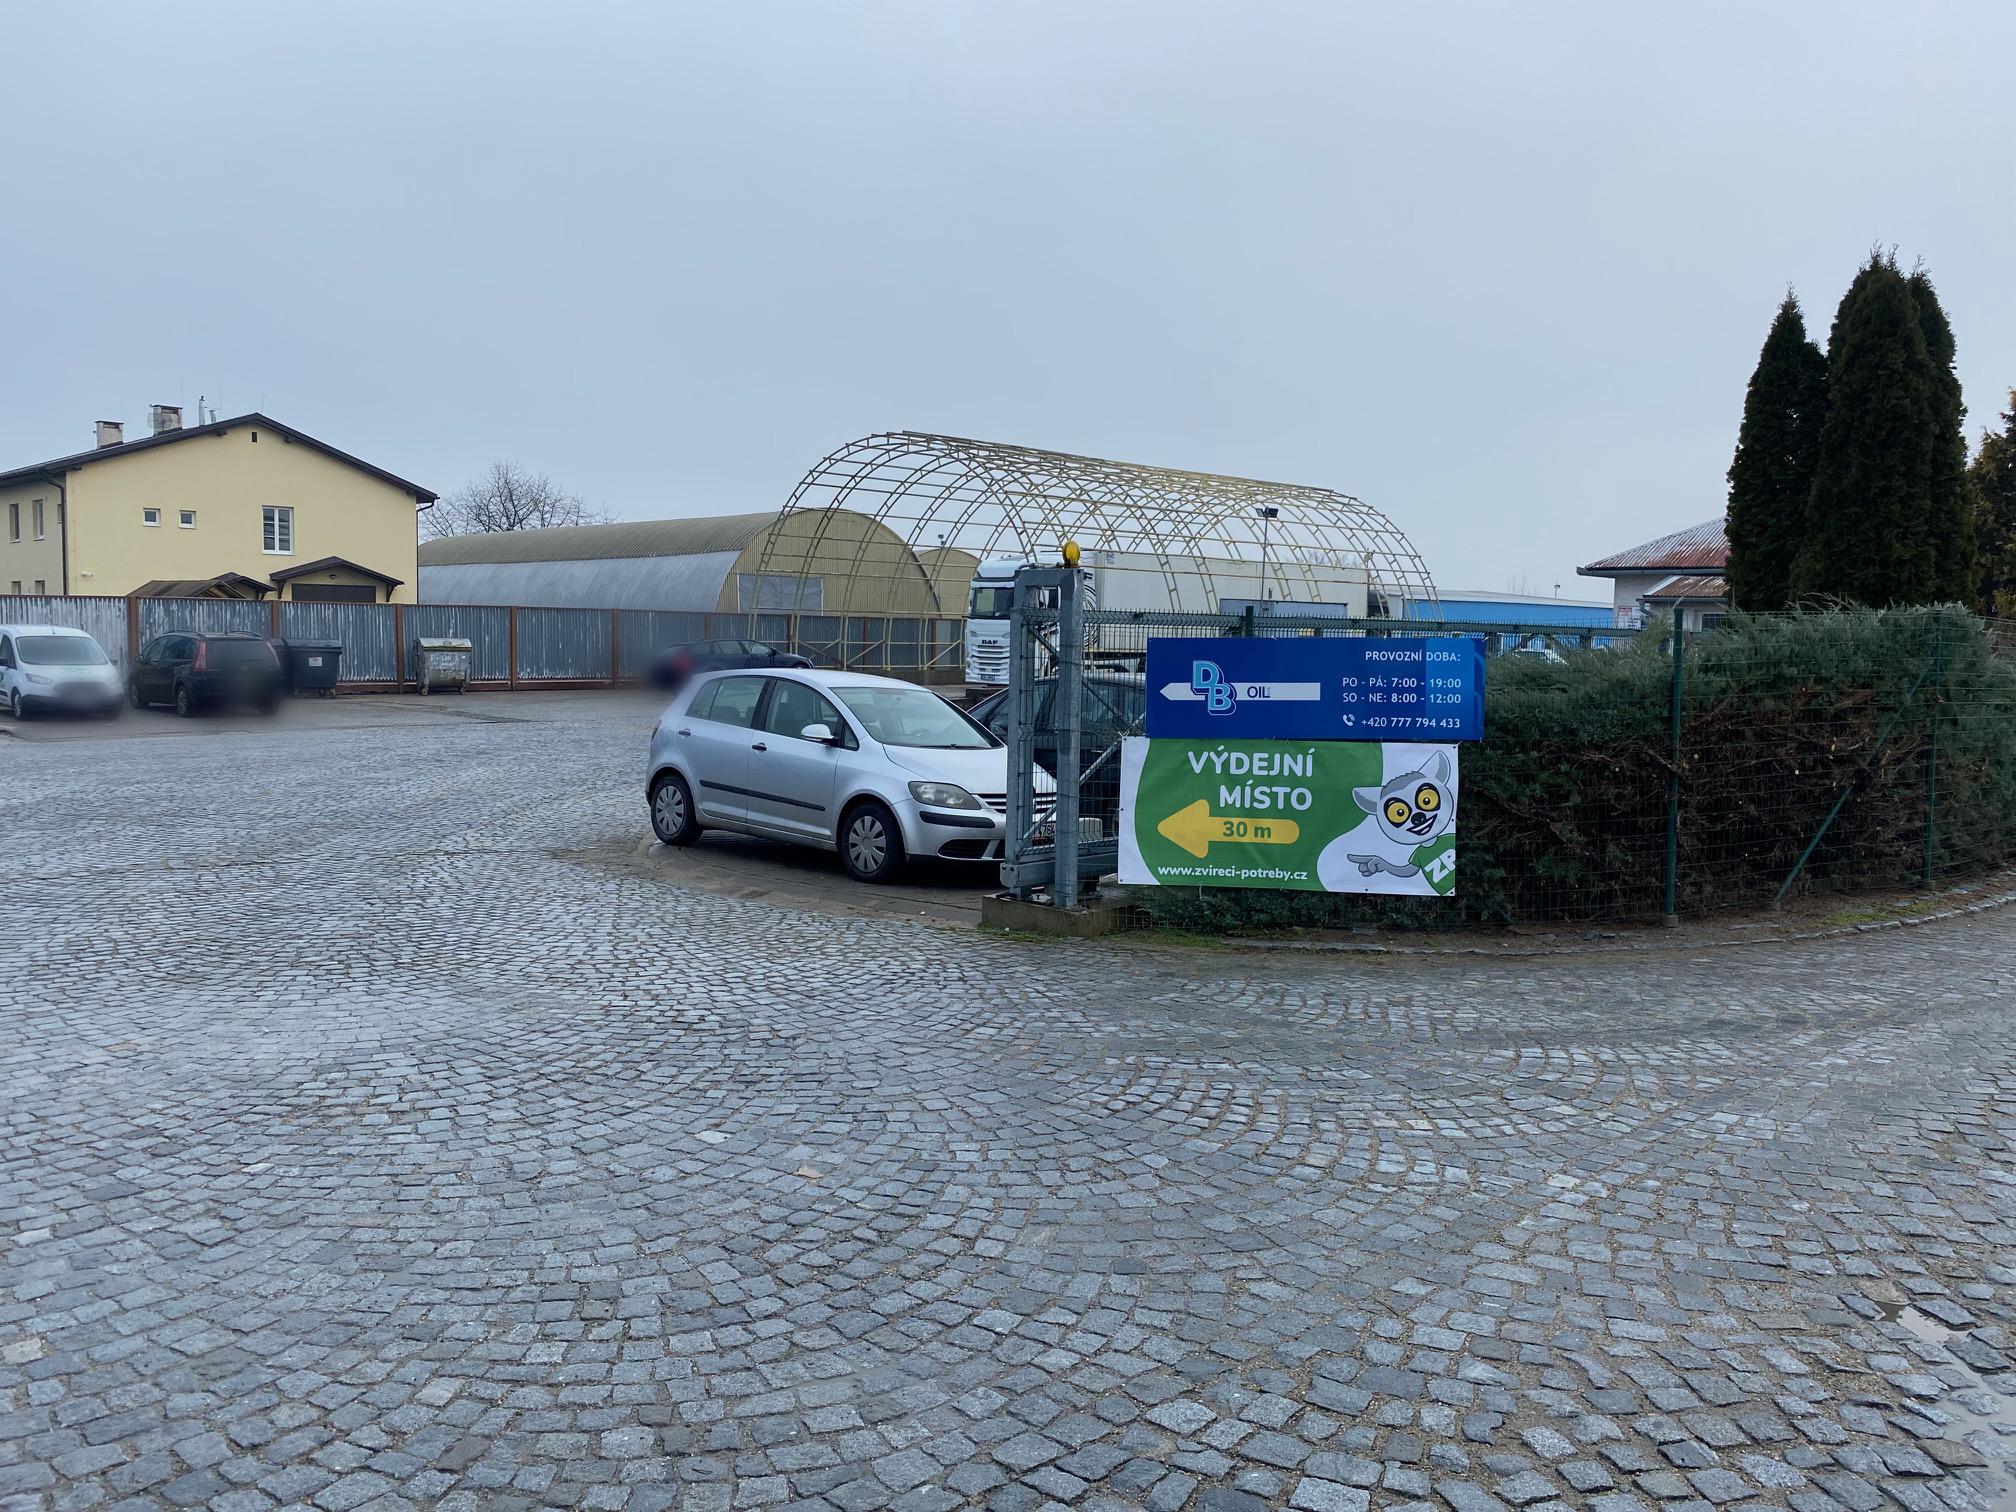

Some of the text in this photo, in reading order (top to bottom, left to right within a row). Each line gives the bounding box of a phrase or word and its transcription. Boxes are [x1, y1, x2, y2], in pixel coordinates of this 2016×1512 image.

[1365, 650, 1461, 662] PROVOZNÍ DOBA:
[1342, 677, 1358, 688] PO
[1369, 675, 1388, 688] PÁ:
[1391, 677, 1417, 688] 7:00
[1429, 678, 1462, 688] 19:00
[1246, 686, 1270, 698] OIL
[1342, 692, 1358, 703] SO
[1369, 693, 1388, 703] NE:
[1391, 693, 1417, 703] 8:00
[1429, 694, 1462, 704] 12:00
[1361, 717, 1461, 729] +420 777 794 433
[1188, 745, 1315, 777] VÝDEJNÍ
[1219, 780, 1313, 811] MÍSTO
[1222, 821, 1272, 839] 30 m
